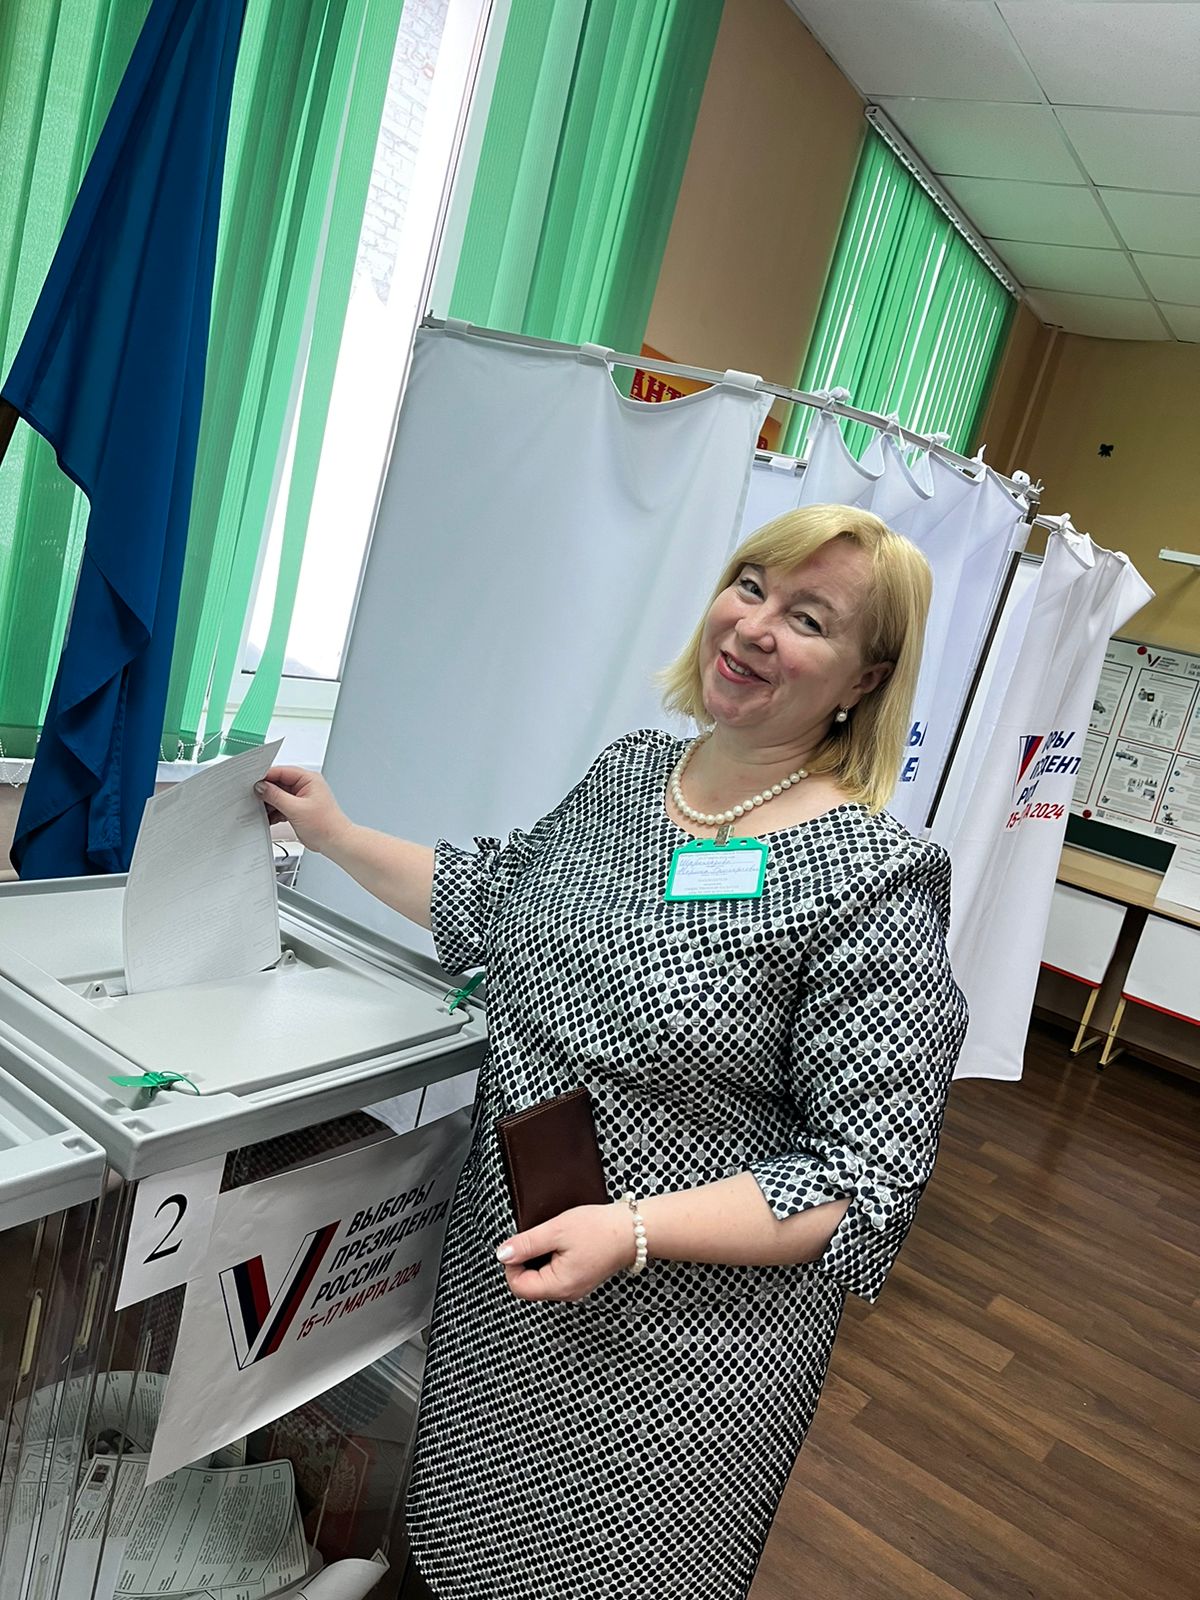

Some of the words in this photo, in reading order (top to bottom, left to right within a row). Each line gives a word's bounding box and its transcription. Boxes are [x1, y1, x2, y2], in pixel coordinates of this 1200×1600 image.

[1029, 802, 1065, 820] 2024
[143, 1193, 189, 1265] 2
[328, 1198, 451, 1273] ПРЕЗИДЕНТА
[346, 1179, 436, 1238] ВЫБОРЫ
[310, 1249, 397, 1309] РОССИИ
[339, 1276, 390, 1318] МАРТА
[388, 1260, 423, 1292] 2024
